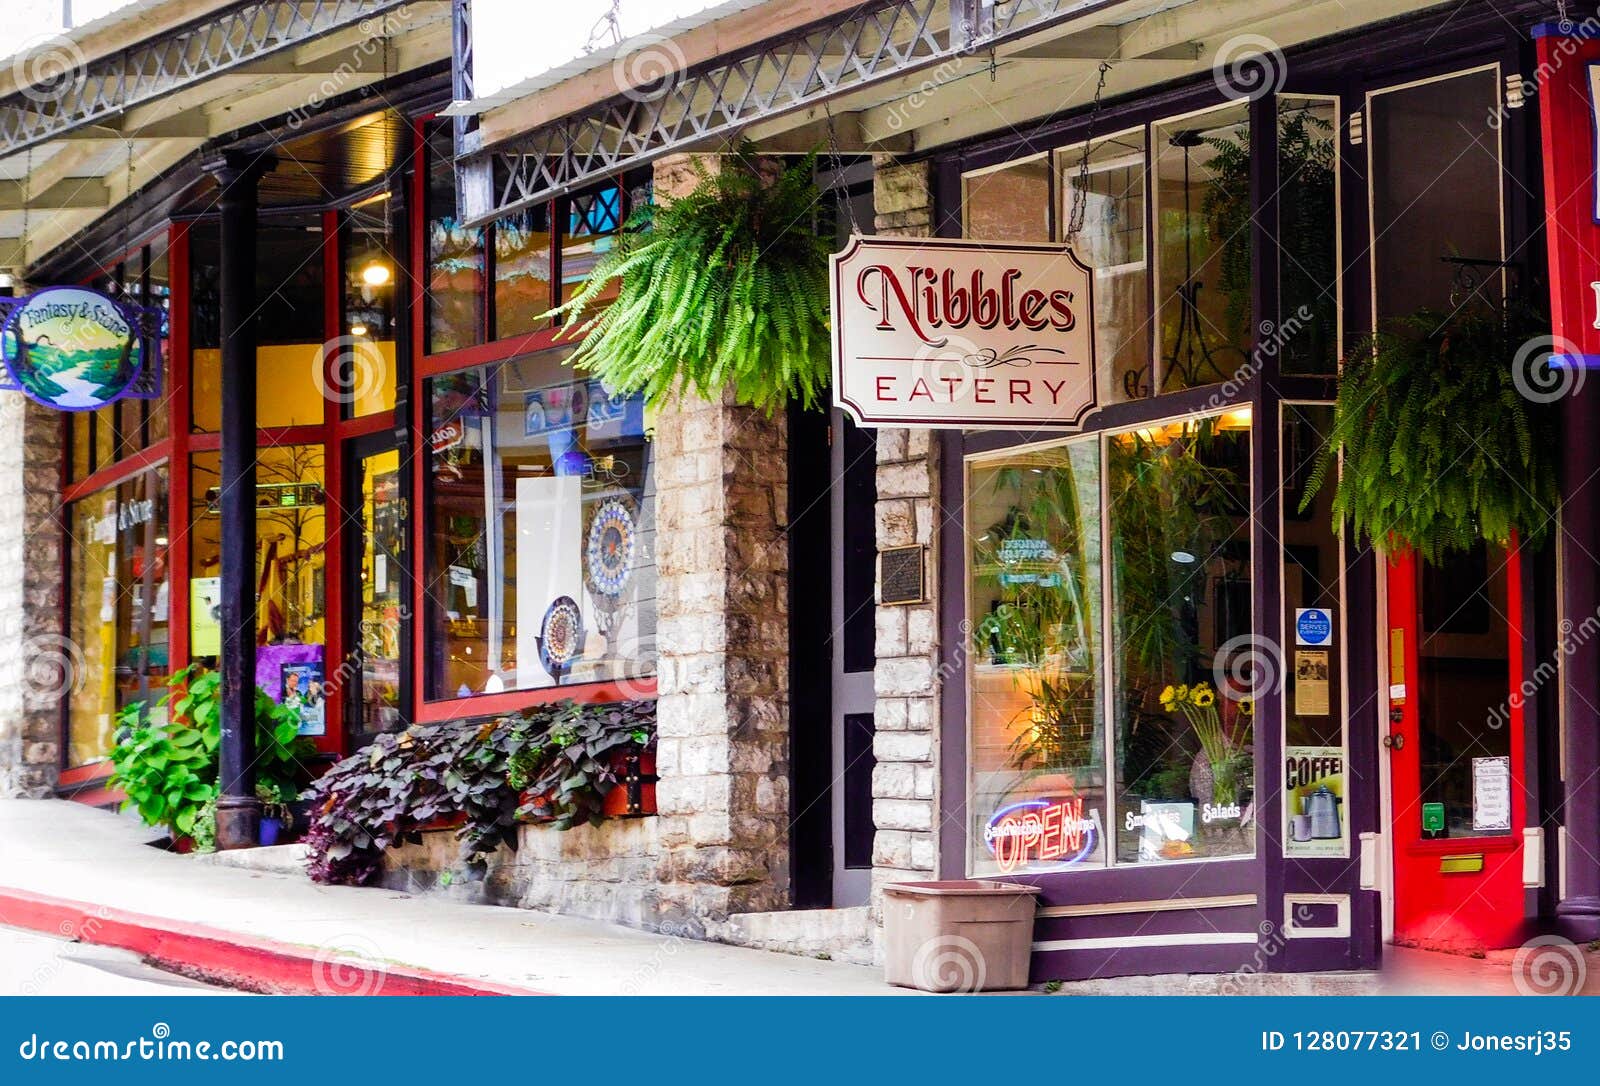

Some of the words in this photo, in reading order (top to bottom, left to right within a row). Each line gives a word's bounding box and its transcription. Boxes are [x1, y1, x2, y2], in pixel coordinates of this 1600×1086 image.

[26, 302, 78, 328] Fantasy
[79, 301, 91, 318] &
[92, 304, 128, 338] Stone
[857, 265, 1076, 348] Nibbles
[876, 376, 1066, 405] EATERY
[1286, 757, 1343, 790] COFFE
[1202, 802, 1241, 823] Salads
[995, 799, 1083, 873] OPEN
